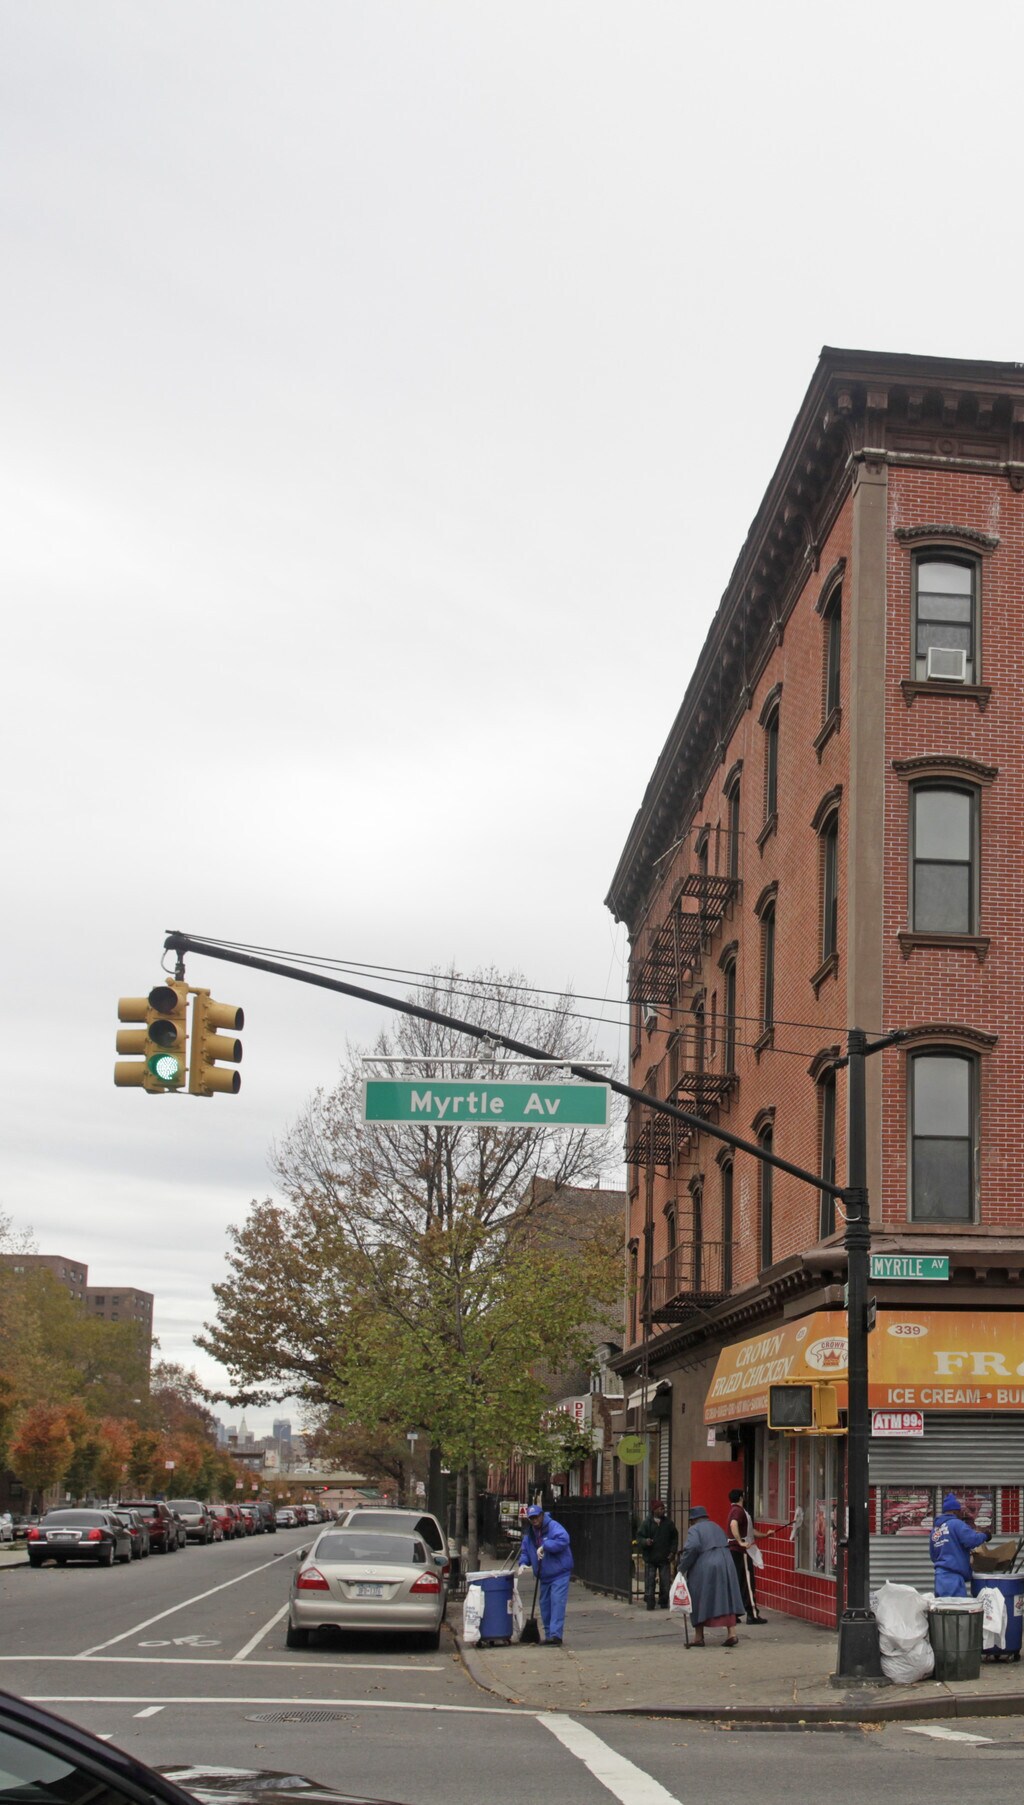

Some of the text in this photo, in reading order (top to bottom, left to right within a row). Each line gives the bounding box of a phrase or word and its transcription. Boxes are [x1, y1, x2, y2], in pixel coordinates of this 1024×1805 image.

[410, 1090, 561, 1119] Myrtle Av
[874, 1258, 945, 1277] MYRTLE AV
[894, 1325, 921, 1336] 339
[735, 1332, 785, 1368] CROWN
[821, 1341, 845, 1349] CROWN
[741, 1355, 795, 1389] CHICKEN
[887, 1388, 915, 1404] ICE
[920, 1388, 981, 1404] CREAM
[874, 1413, 902, 1429] ATM
